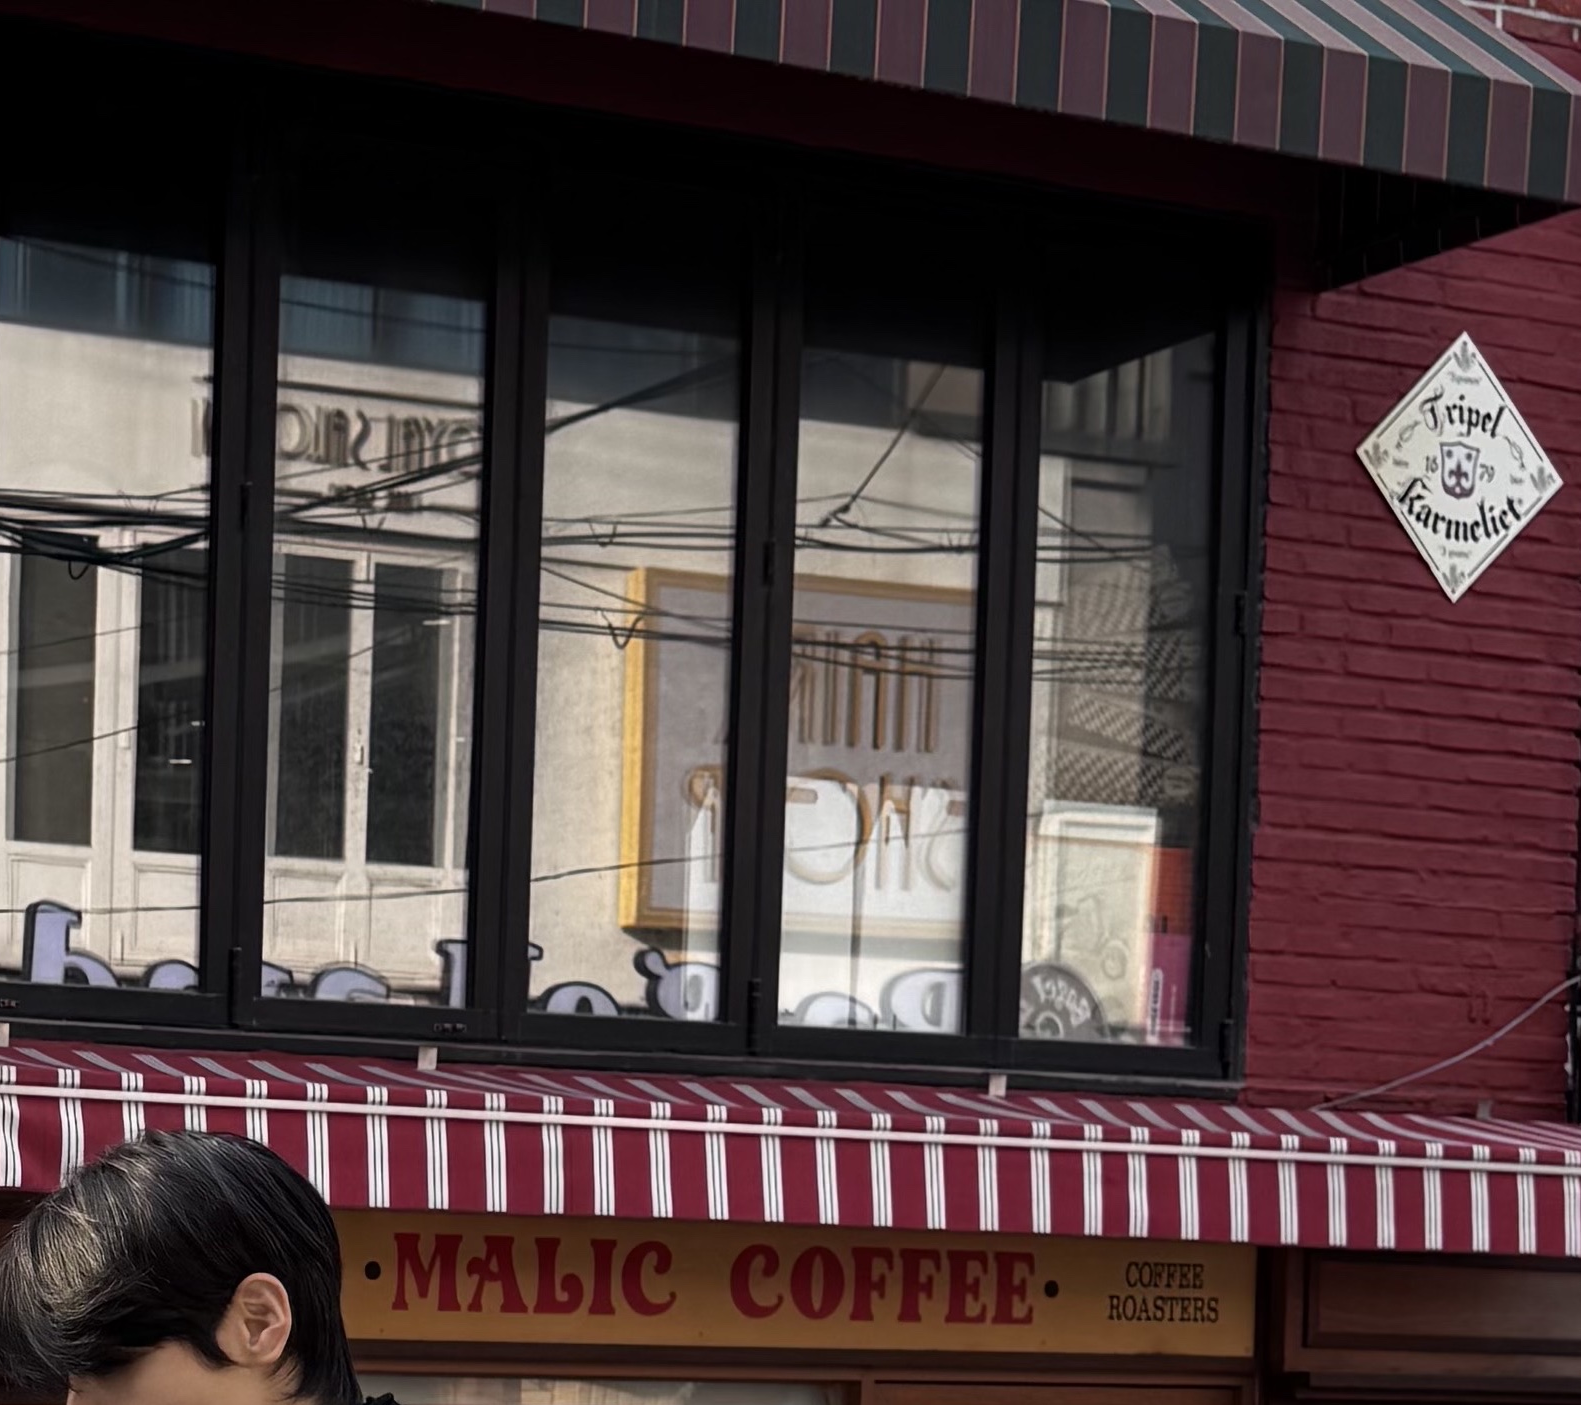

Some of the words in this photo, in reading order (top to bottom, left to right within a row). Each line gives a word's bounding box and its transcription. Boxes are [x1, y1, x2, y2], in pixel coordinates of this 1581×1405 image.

[1420, 384, 1507, 438] Tripel
[1394, 478, 1523, 543] Karmeliet
[392, 1231, 677, 1317] MALIC
[729, 1243, 1036, 1326] COFFEE
[1125, 1261, 1205, 1290] COFFEE
[1107, 1295, 1220, 1325] ROASTERS
